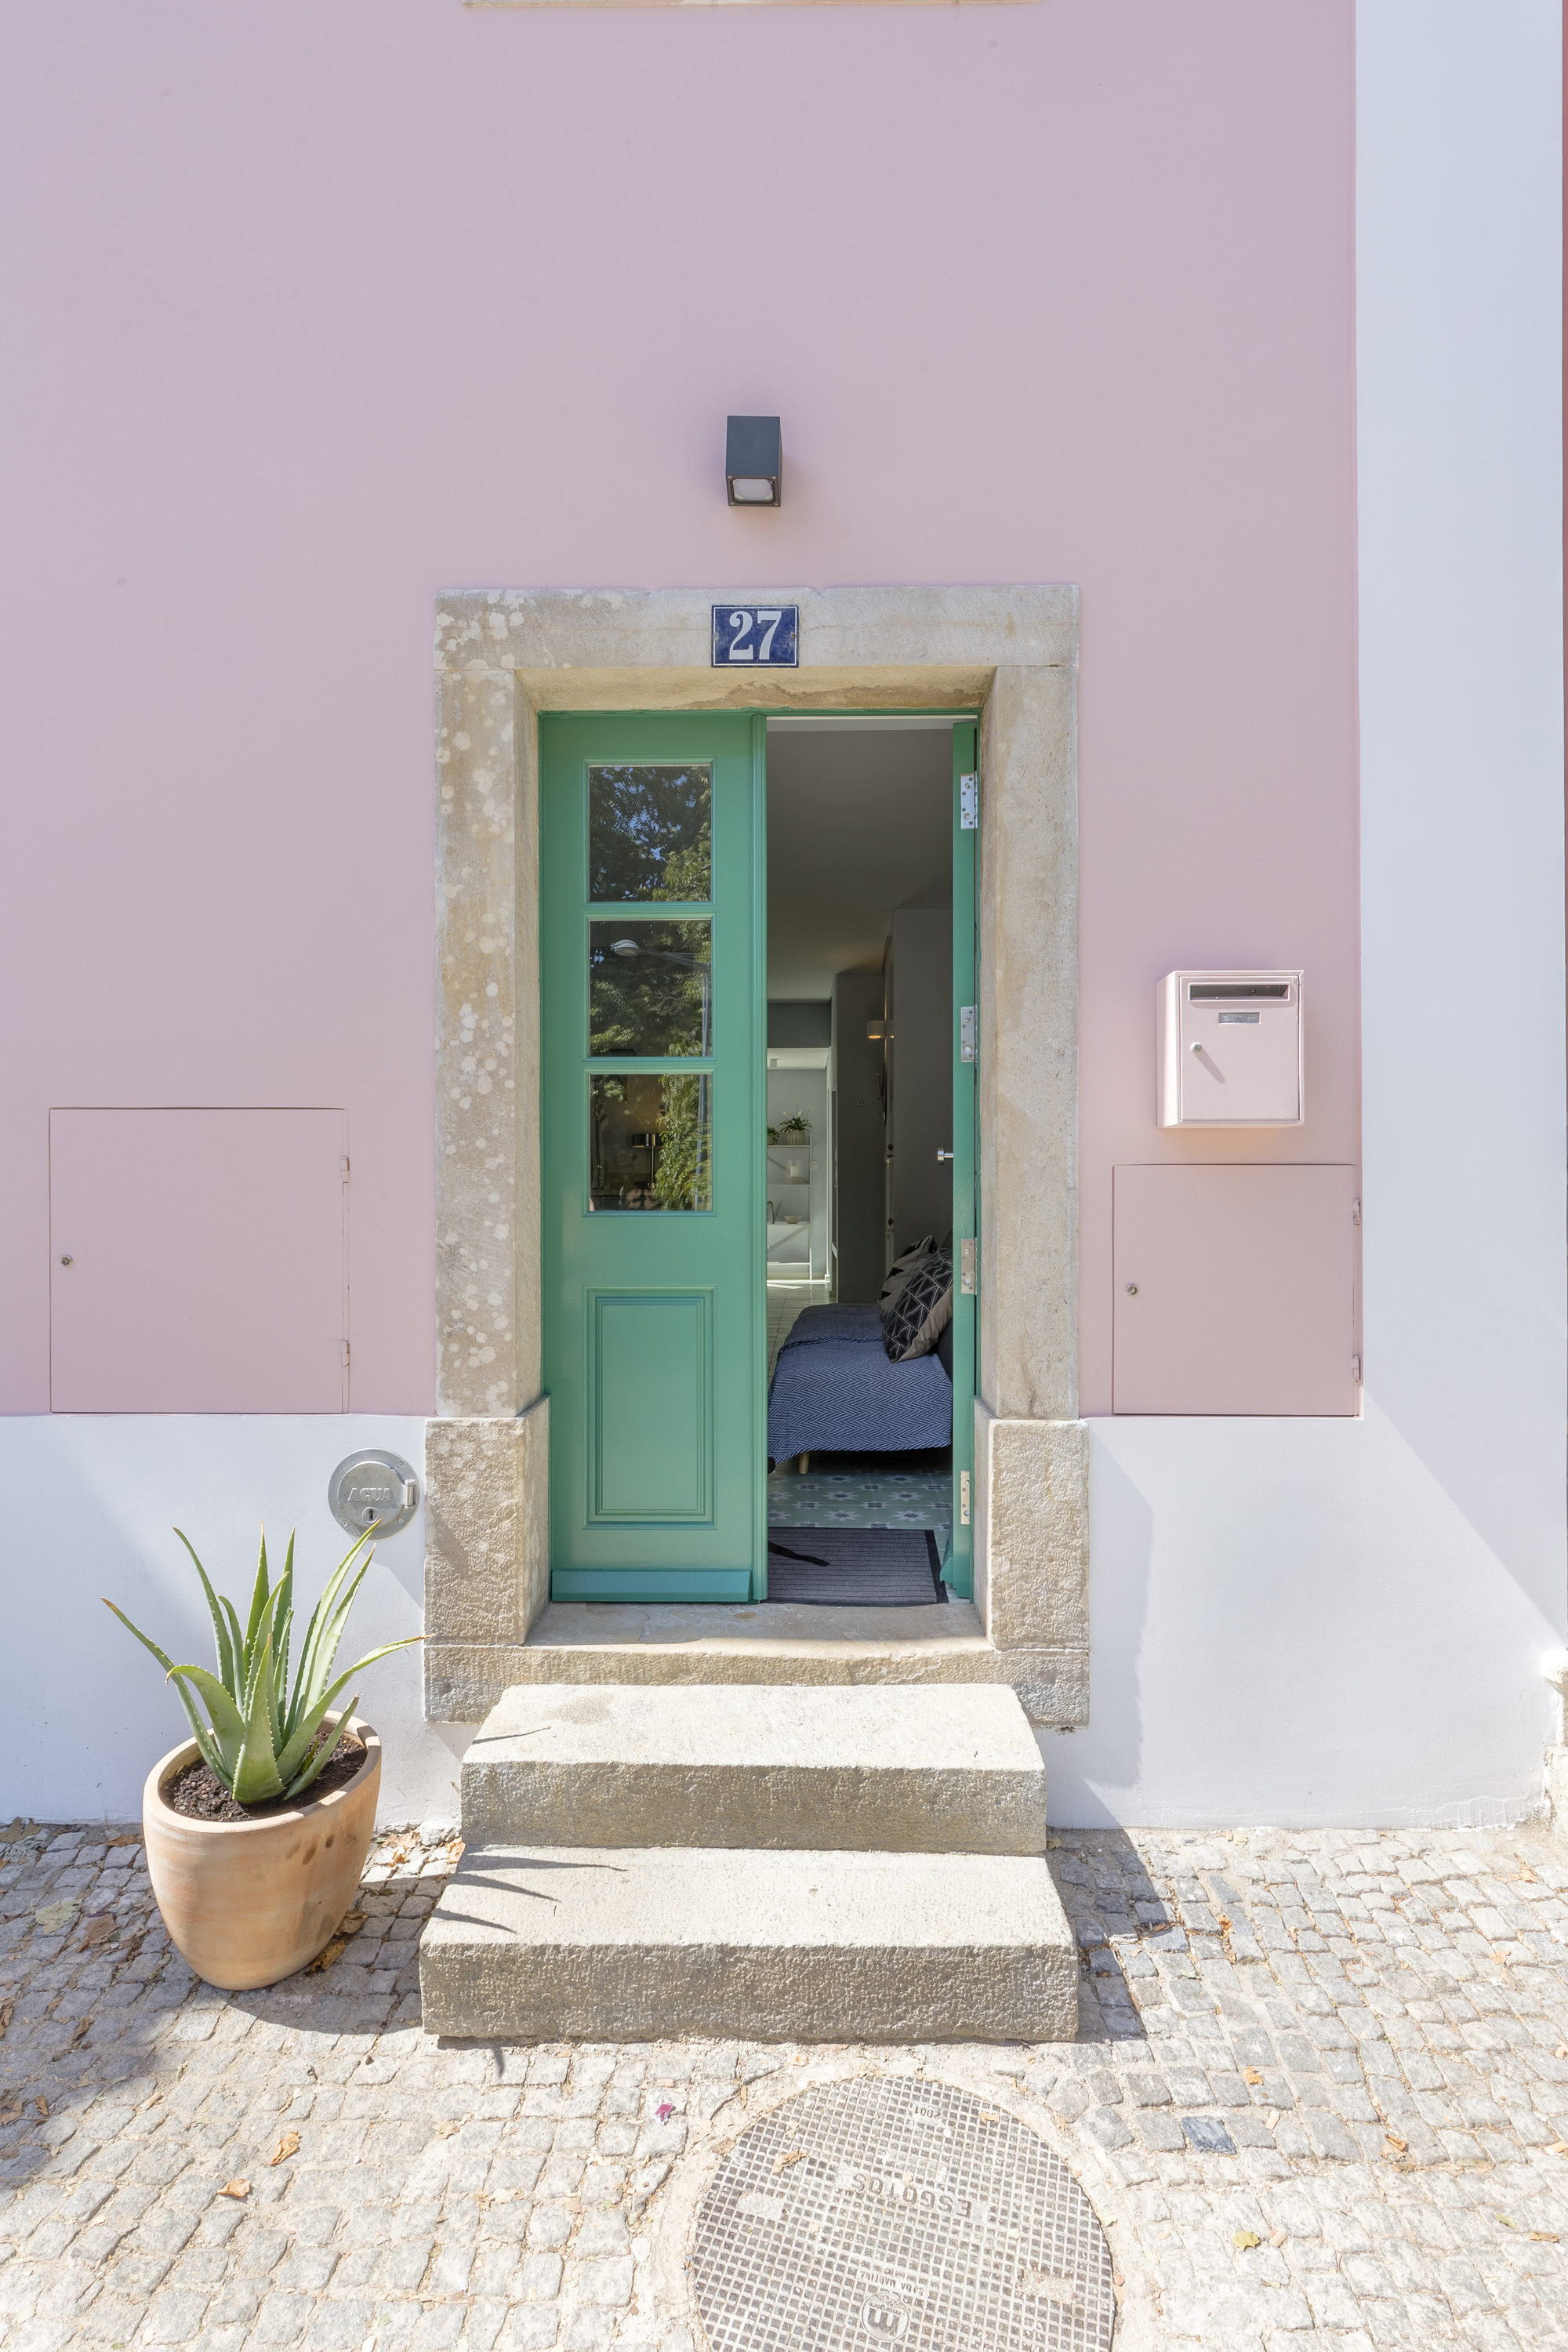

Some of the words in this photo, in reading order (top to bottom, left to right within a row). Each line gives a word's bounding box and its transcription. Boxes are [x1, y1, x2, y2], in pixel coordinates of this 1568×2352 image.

[729, 611, 782, 660] 27
[347, 1487, 394, 1503] AGUA
[914, 2105, 942, 2119] 2001
[851, 2173, 972, 2219] ESGOTOS
[860, 2270, 896, 2288] MADEIRA
